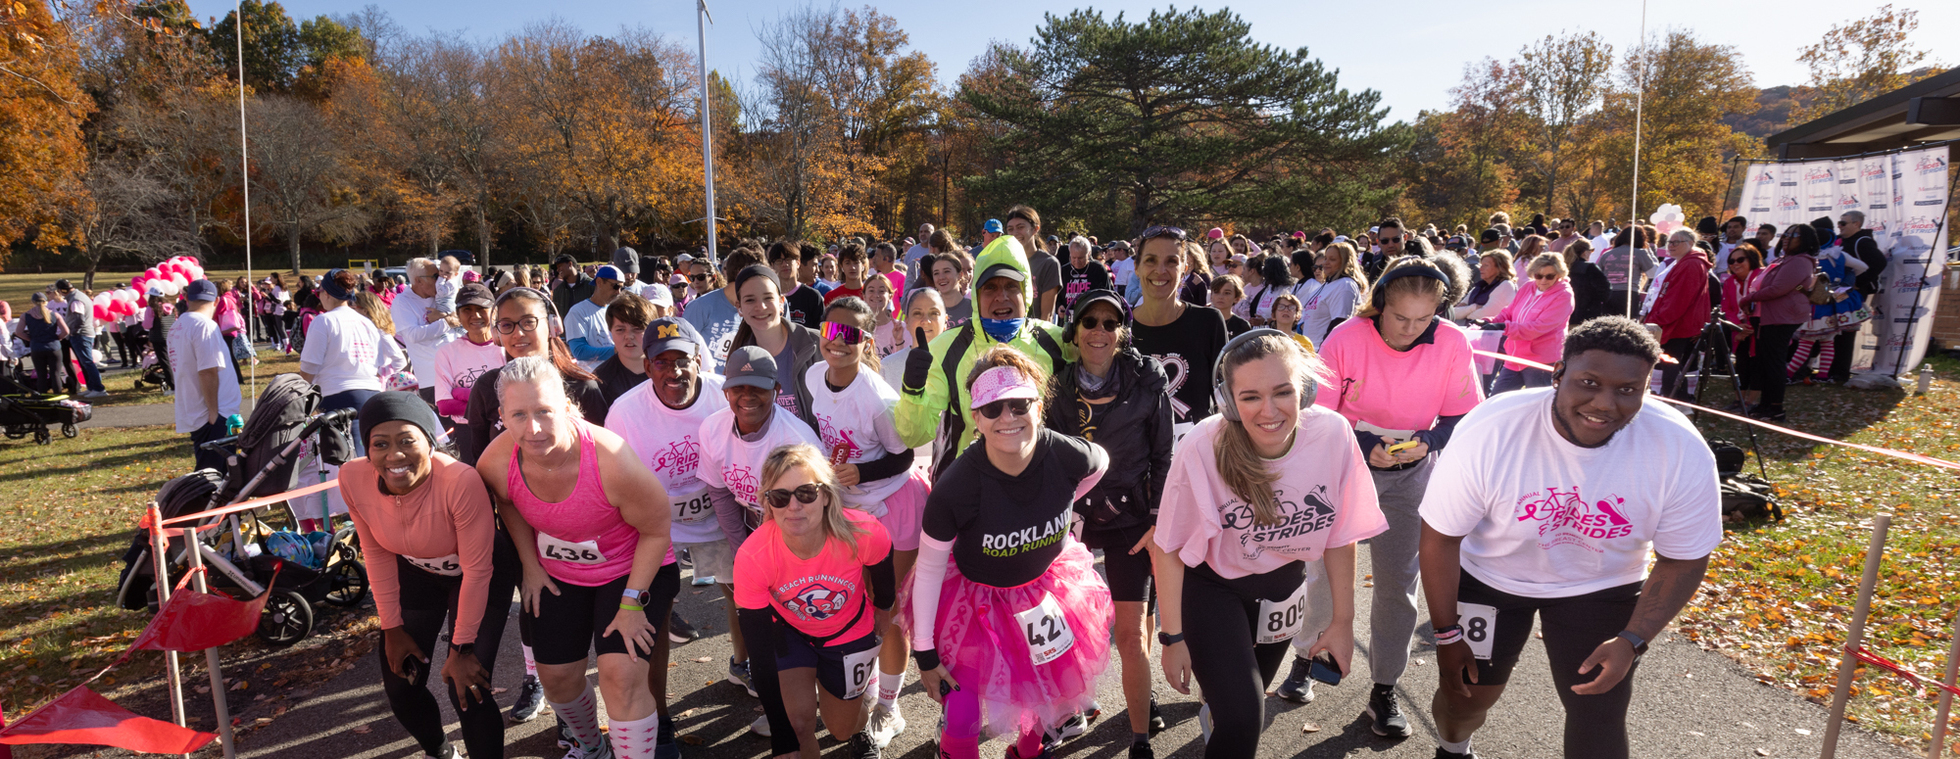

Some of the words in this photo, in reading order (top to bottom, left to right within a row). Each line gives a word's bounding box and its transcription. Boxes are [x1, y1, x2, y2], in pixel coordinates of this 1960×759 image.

[1066, 282, 1091, 294] HOPE
[657, 323, 680, 339] M
[676, 452, 699, 467] RID
[735, 482, 758, 494] RID
[674, 493, 712, 517] 795
[1552, 506, 1608, 527] RIDES
[982, 507, 1071, 550] ROCKLAND
[1252, 513, 1336, 542] STRIDES
[1550, 516, 1633, 539] STRIDES
[545, 545, 598, 560] 436
[983, 547, 1017, 558] ROAD
[778, 576, 806, 593] BEACH
[808, 573, 848, 586] RUNNING
[1267, 595, 1304, 632] 809
[1467, 616, 1487, 642] 8
